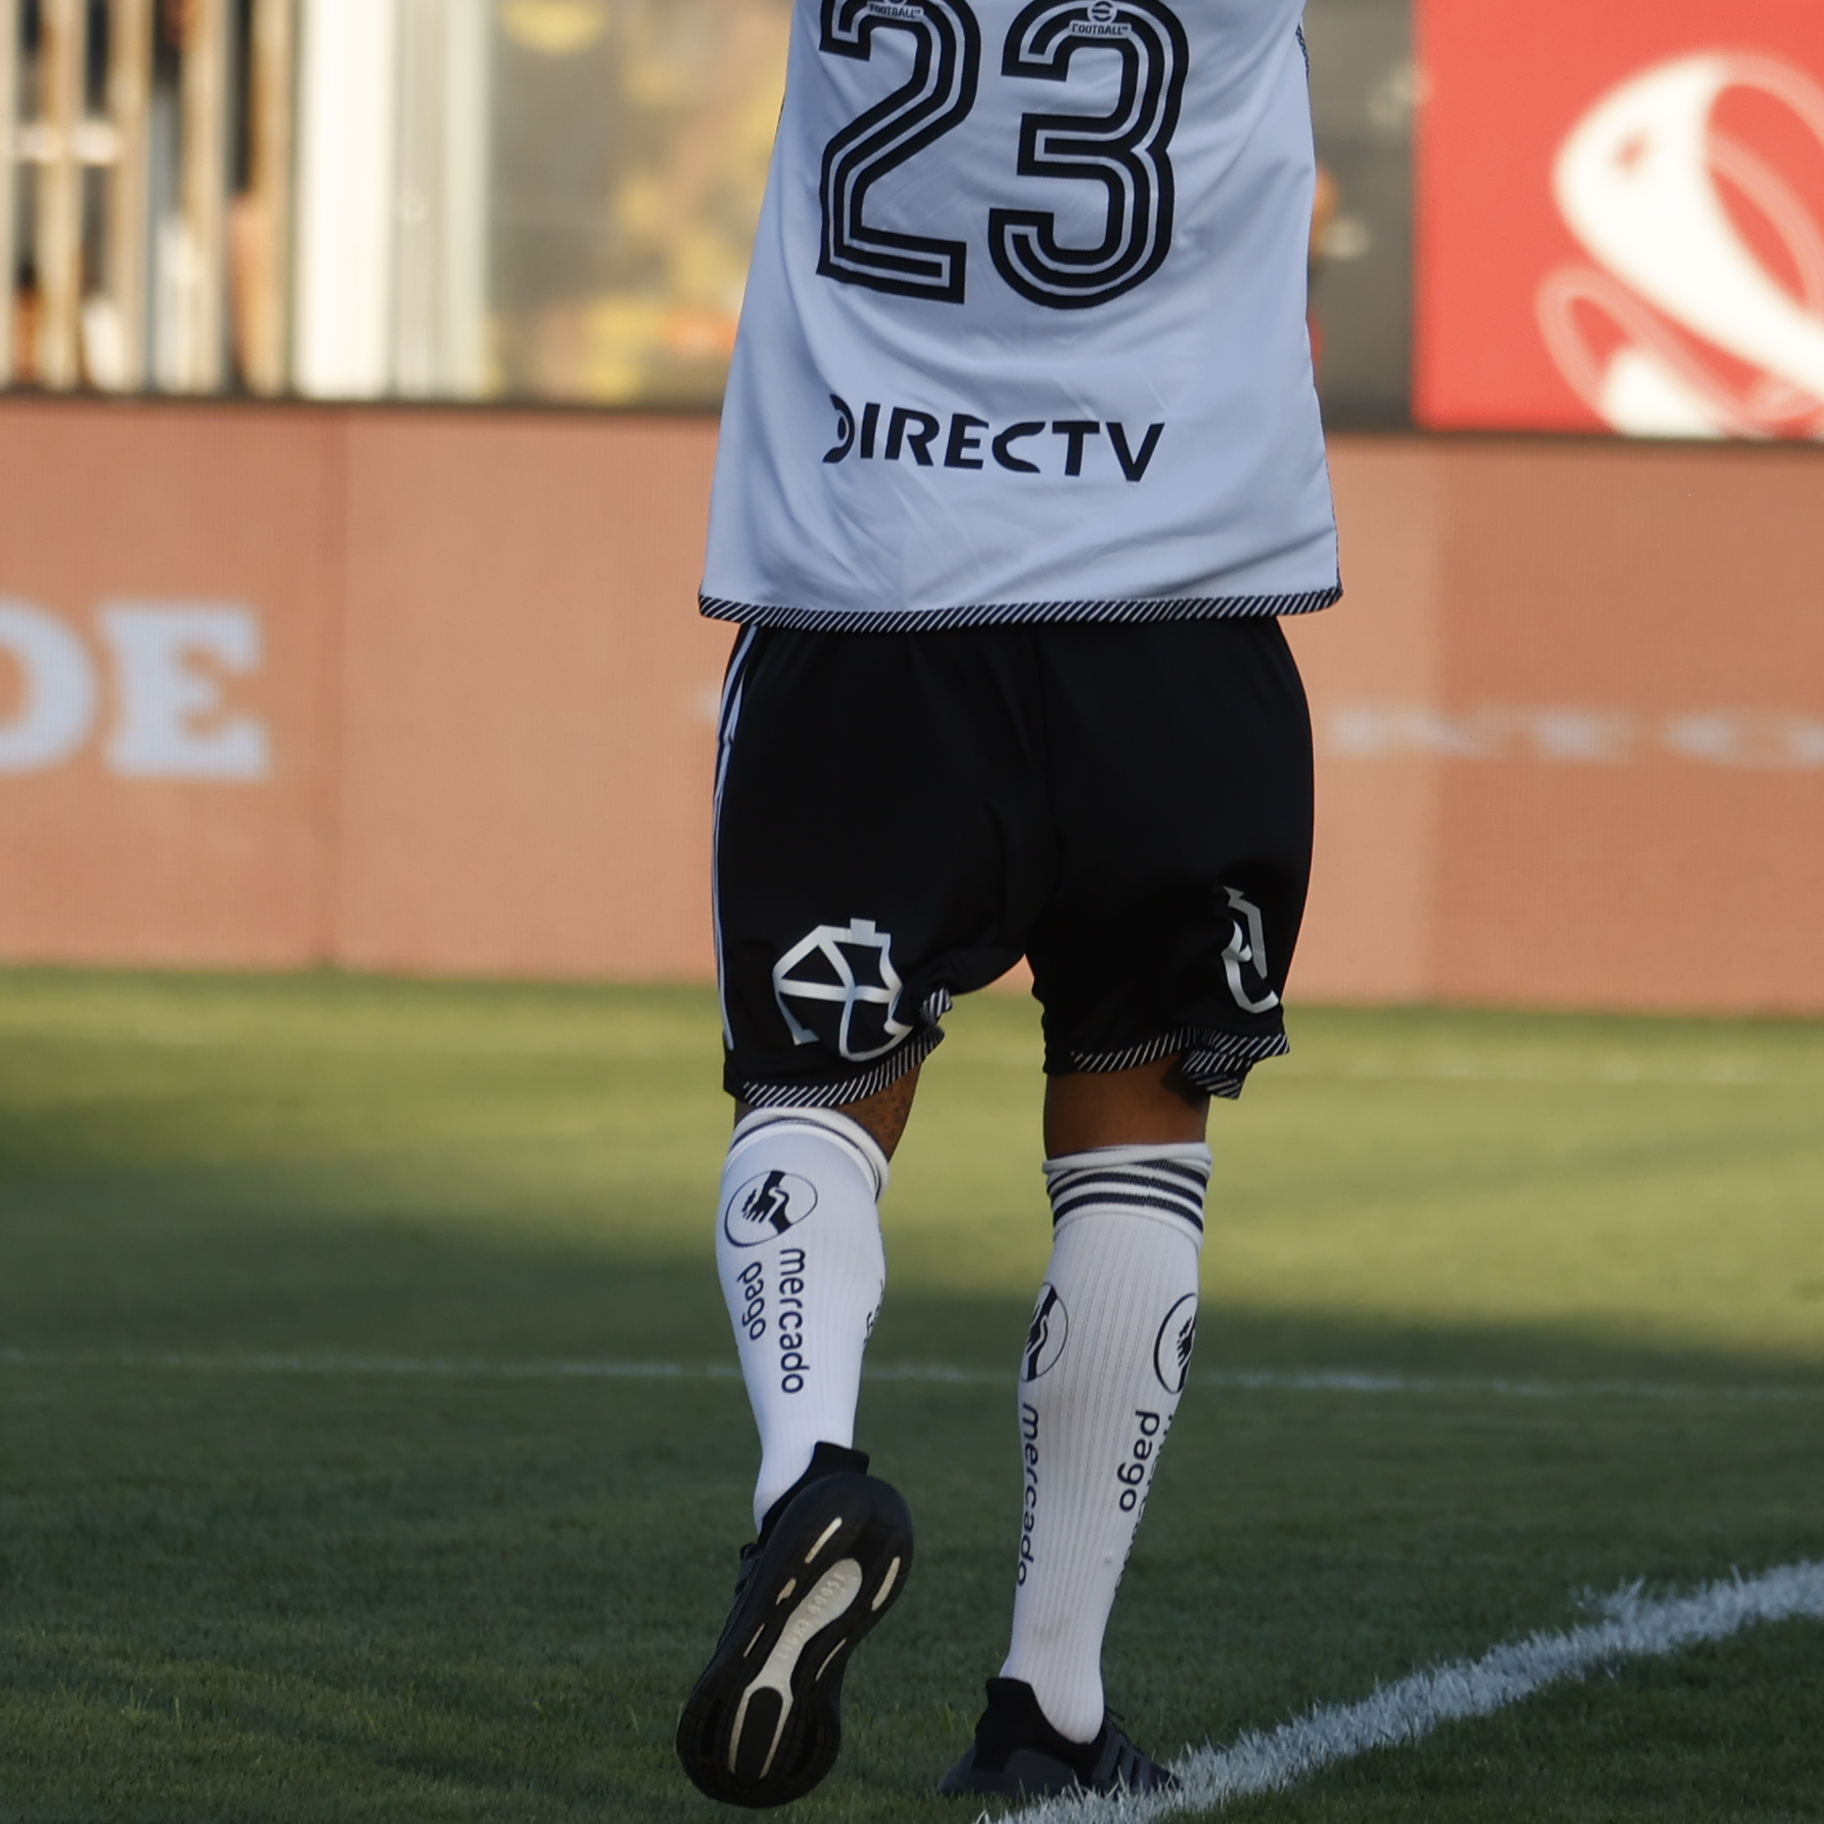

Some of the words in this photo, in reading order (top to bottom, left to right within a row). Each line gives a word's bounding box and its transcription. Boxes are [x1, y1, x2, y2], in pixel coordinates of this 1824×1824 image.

[822, 393, 1166, 483] DIRECTV
[736, 1261, 767, 1341] pago
[778, 1247, 810, 1394] mercado
[1016, 1402, 1040, 1587] mercado
[1116, 1409, 1160, 1513] pago
